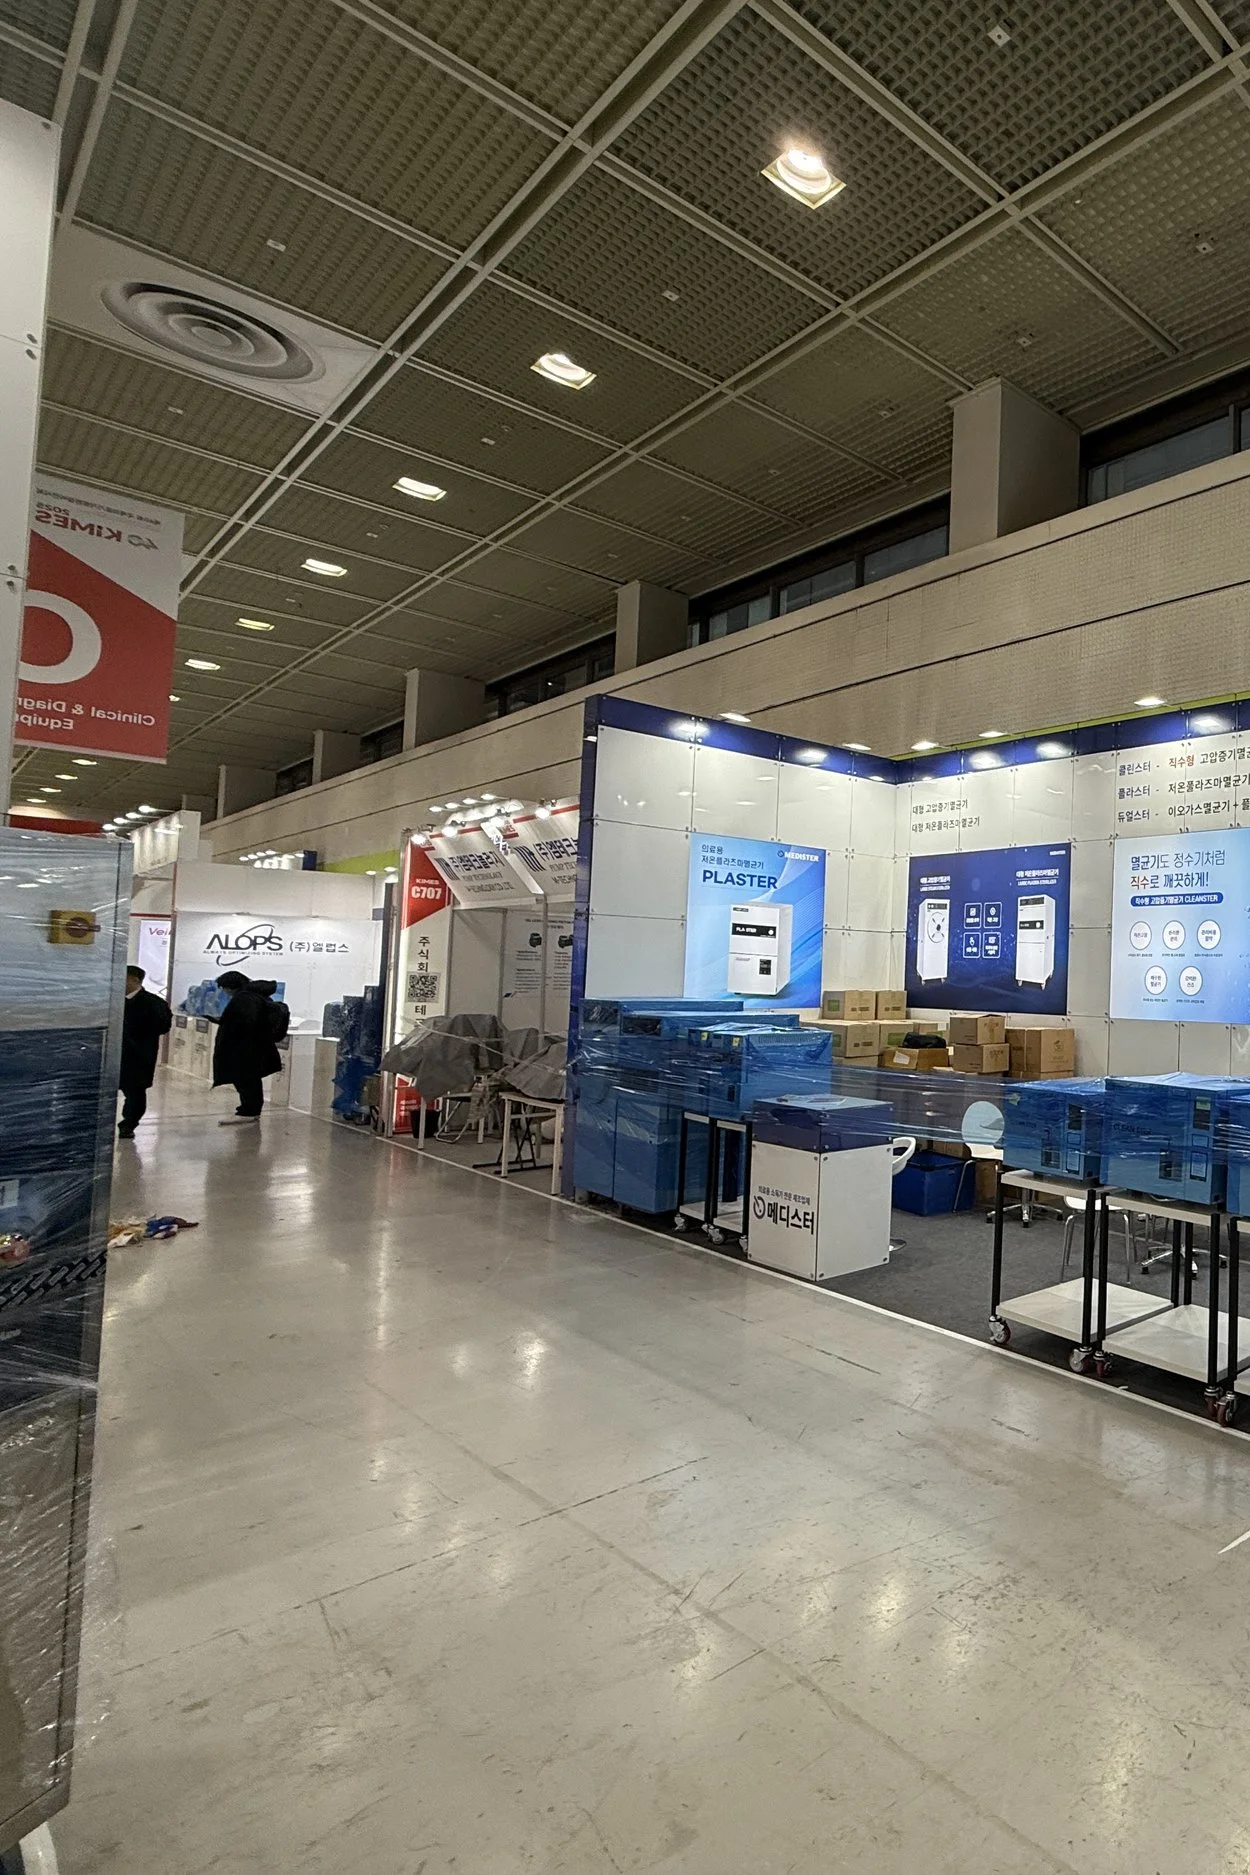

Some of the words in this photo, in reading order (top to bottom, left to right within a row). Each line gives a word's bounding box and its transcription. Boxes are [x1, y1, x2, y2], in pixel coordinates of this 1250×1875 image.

[1119, 761, 1150, 776] 클린스터
[1169, 755, 1195, 769] 직수형
[1118, 784, 1150, 799] 플라스터
[1168, 773, 1250, 794] 저온플라즈마멸균기
[912, 805, 924, 814] 대형
[1118, 808, 1150, 823] 듀얼스터
[1168, 800, 1230, 817] 이오가스멸균기
[912, 823, 923, 832] 대형
[701, 844, 723, 854] 의료용
[784, 852, 819, 862] MEDISTER
[1131, 854, 1170, 871] 멸균기도
[1174, 850, 1225, 868] 정수기처럼
[702, 869, 778, 889] PLASTER
[1130, 874, 1159, 889] 직수로
[1164, 872, 1209, 888] 깨끗하게!
[411, 886, 442, 900] C707
[1184, 894, 1218, 903] CLEANSTER
[767, 1202, 814, 1235] 메디스터
